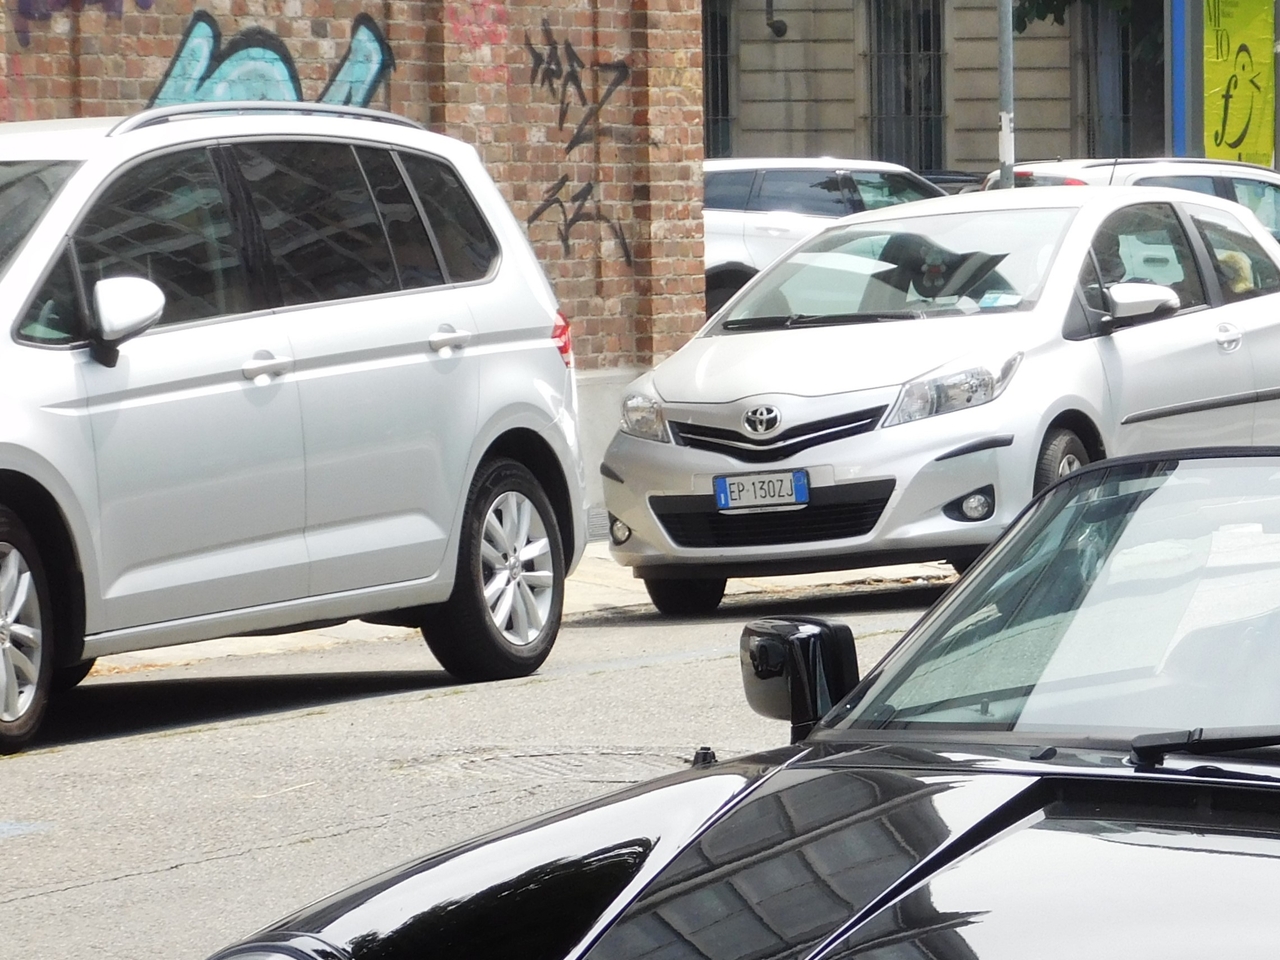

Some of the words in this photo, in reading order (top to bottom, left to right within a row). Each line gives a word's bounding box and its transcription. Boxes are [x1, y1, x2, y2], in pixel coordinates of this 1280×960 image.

[1213, 28, 1230, 62] TO
[728, 481, 745, 501] EP
[751, 478, 794, 500] 130ZJ
